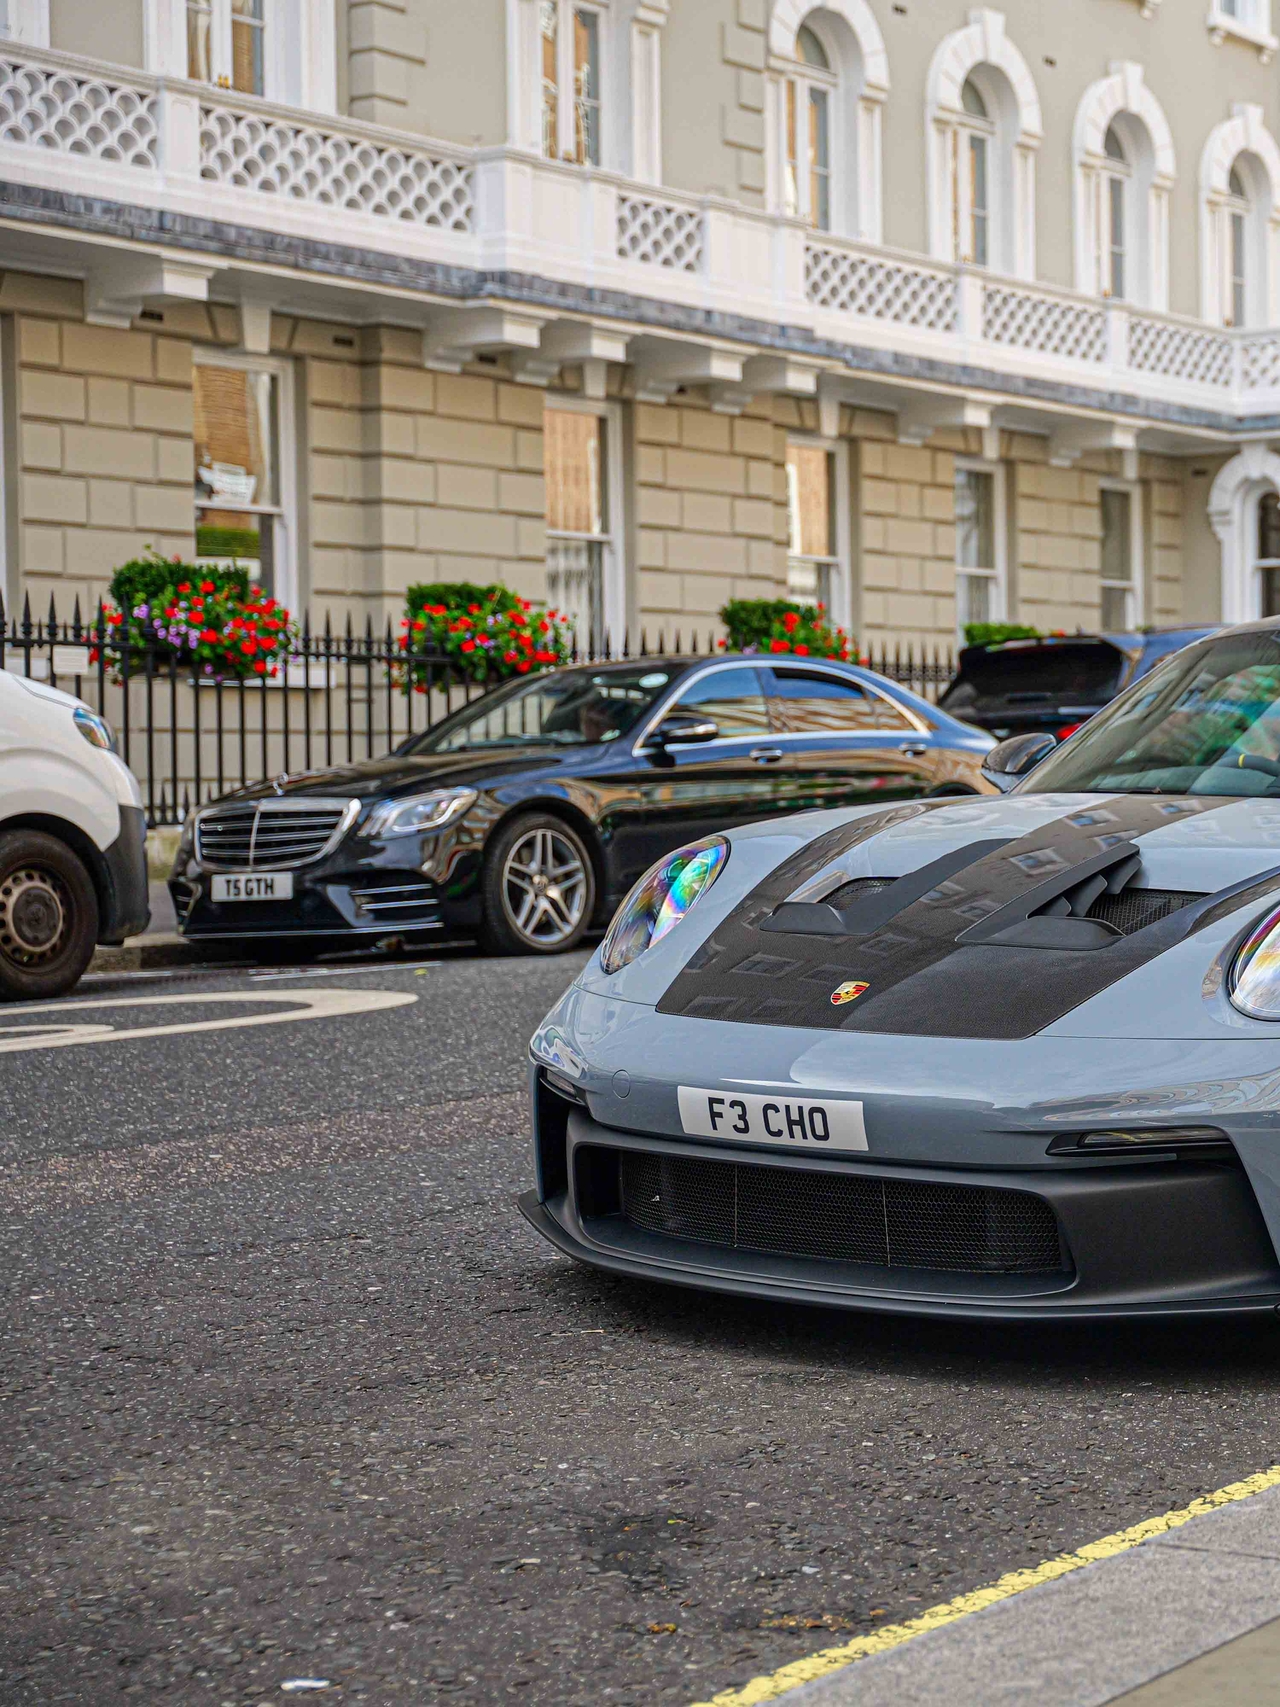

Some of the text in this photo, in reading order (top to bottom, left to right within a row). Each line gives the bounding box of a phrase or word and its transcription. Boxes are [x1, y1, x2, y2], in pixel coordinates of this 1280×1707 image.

[224, 877, 274, 896] T5 GTH
[708, 1096, 830, 1142] F3 CHO
